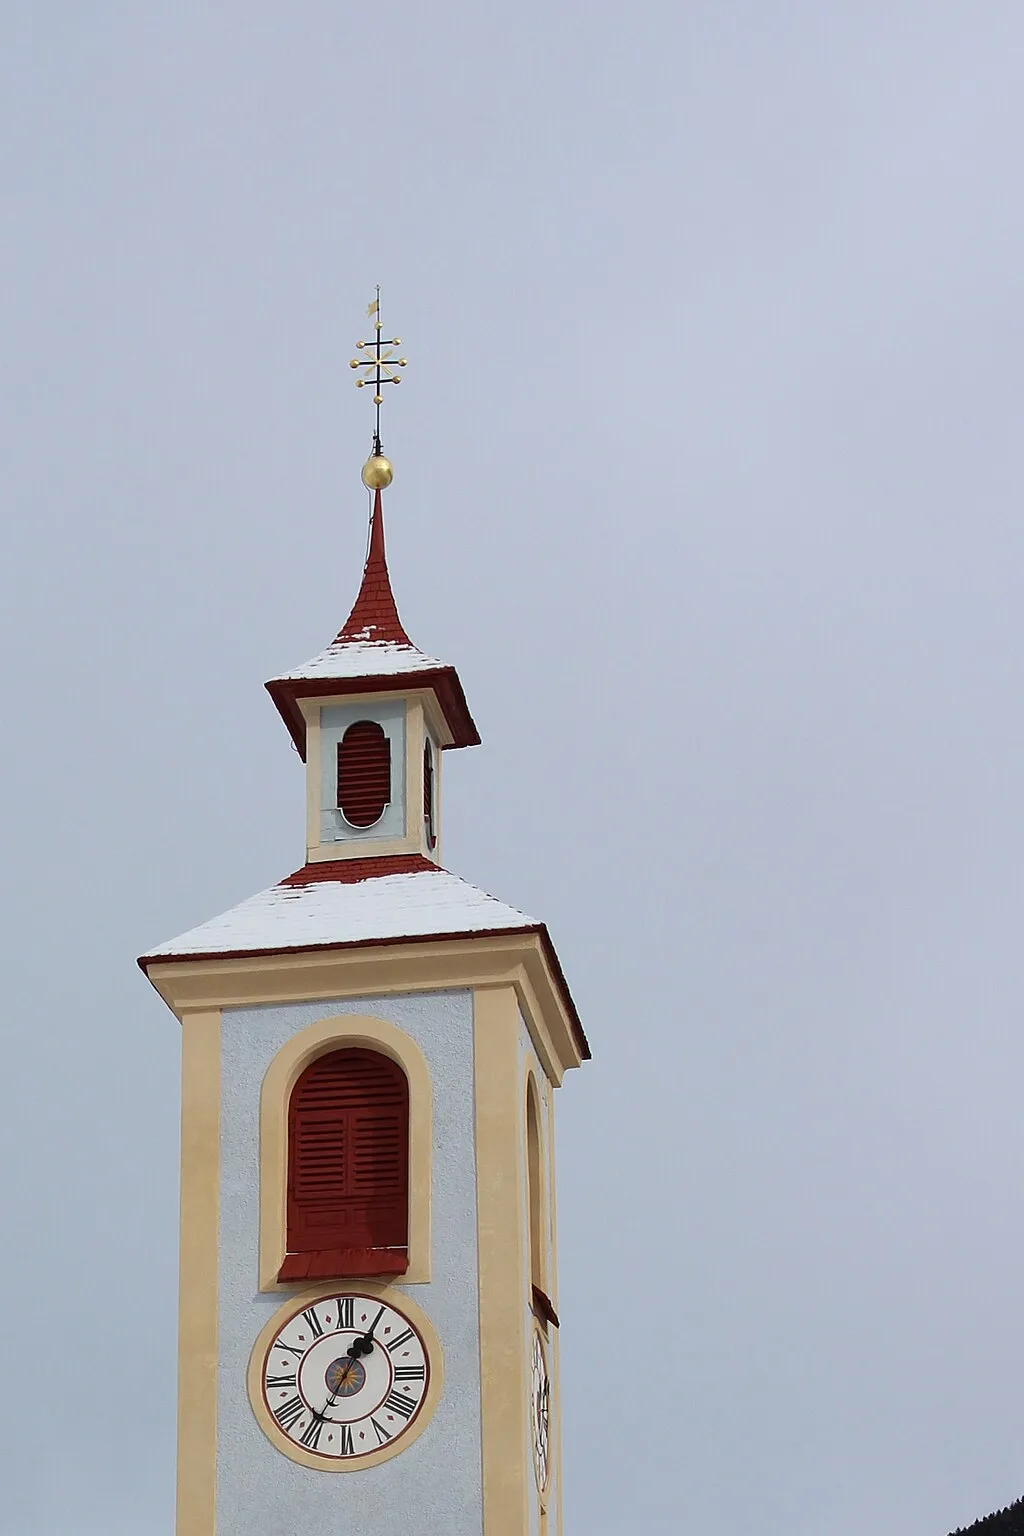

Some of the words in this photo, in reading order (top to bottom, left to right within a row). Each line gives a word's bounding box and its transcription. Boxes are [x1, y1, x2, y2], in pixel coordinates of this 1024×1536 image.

[301, 1307, 324, 1340] XI
[336, 1298, 355, 1329] XII
[274, 1338, 305, 1360] X
[385, 1327, 416, 1354] II
[266, 1373, 297, 1388] IX
[394, 1364, 425, 1382] III
[273, 1394, 307, 1432] VIII
[383, 1388, 418, 1421] IIII
[299, 1418, 326, 1450] VII
[340, 1424, 355, 1455] VI
[370, 1415, 393, 1444] V
